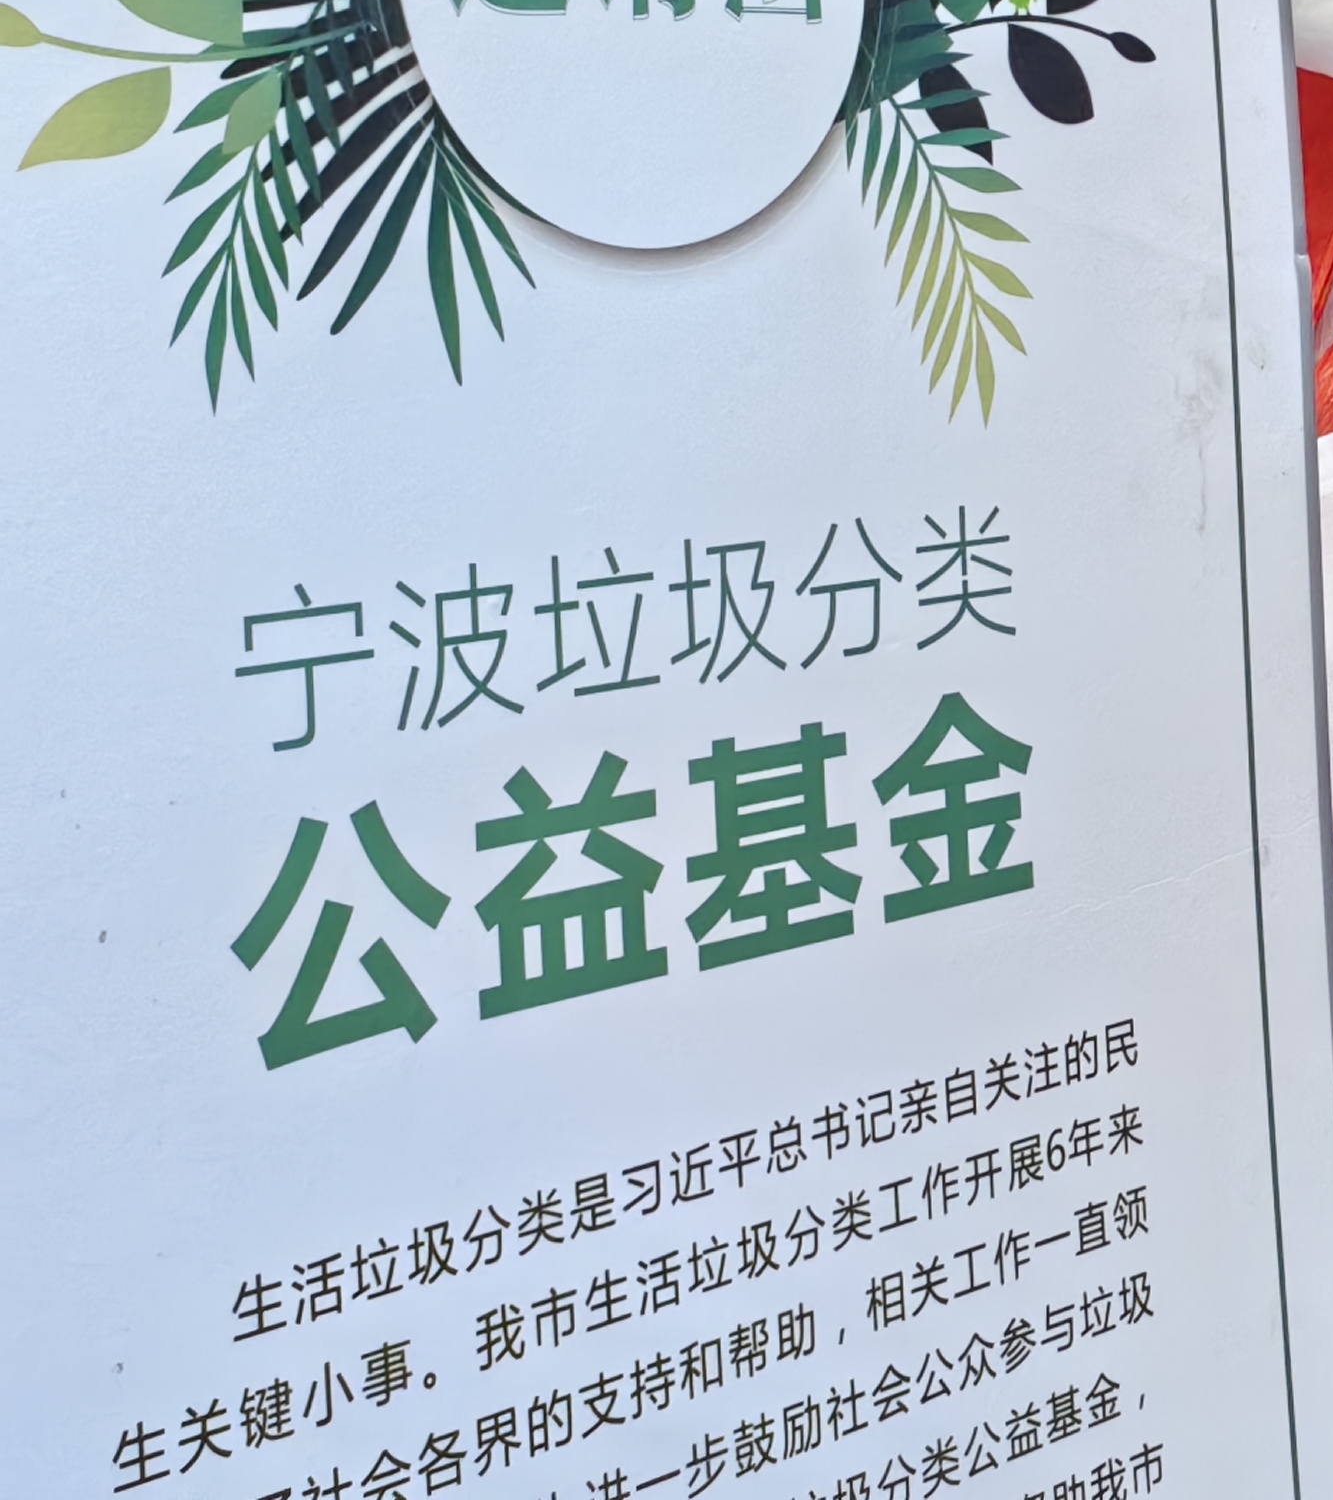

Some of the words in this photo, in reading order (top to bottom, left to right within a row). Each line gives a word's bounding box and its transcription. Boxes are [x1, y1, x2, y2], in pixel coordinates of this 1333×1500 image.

[234, 505, 1017, 752] 宁波垃圾分类
[230, 691, 1035, 1072] 公益基金
[233, 1018, 1138, 1342] 生活垃圾分类是习近平总书记亲自关注的民
[256, 1186, 1149, 1500] 社会各界的支持和帮助，相关工作一直领
